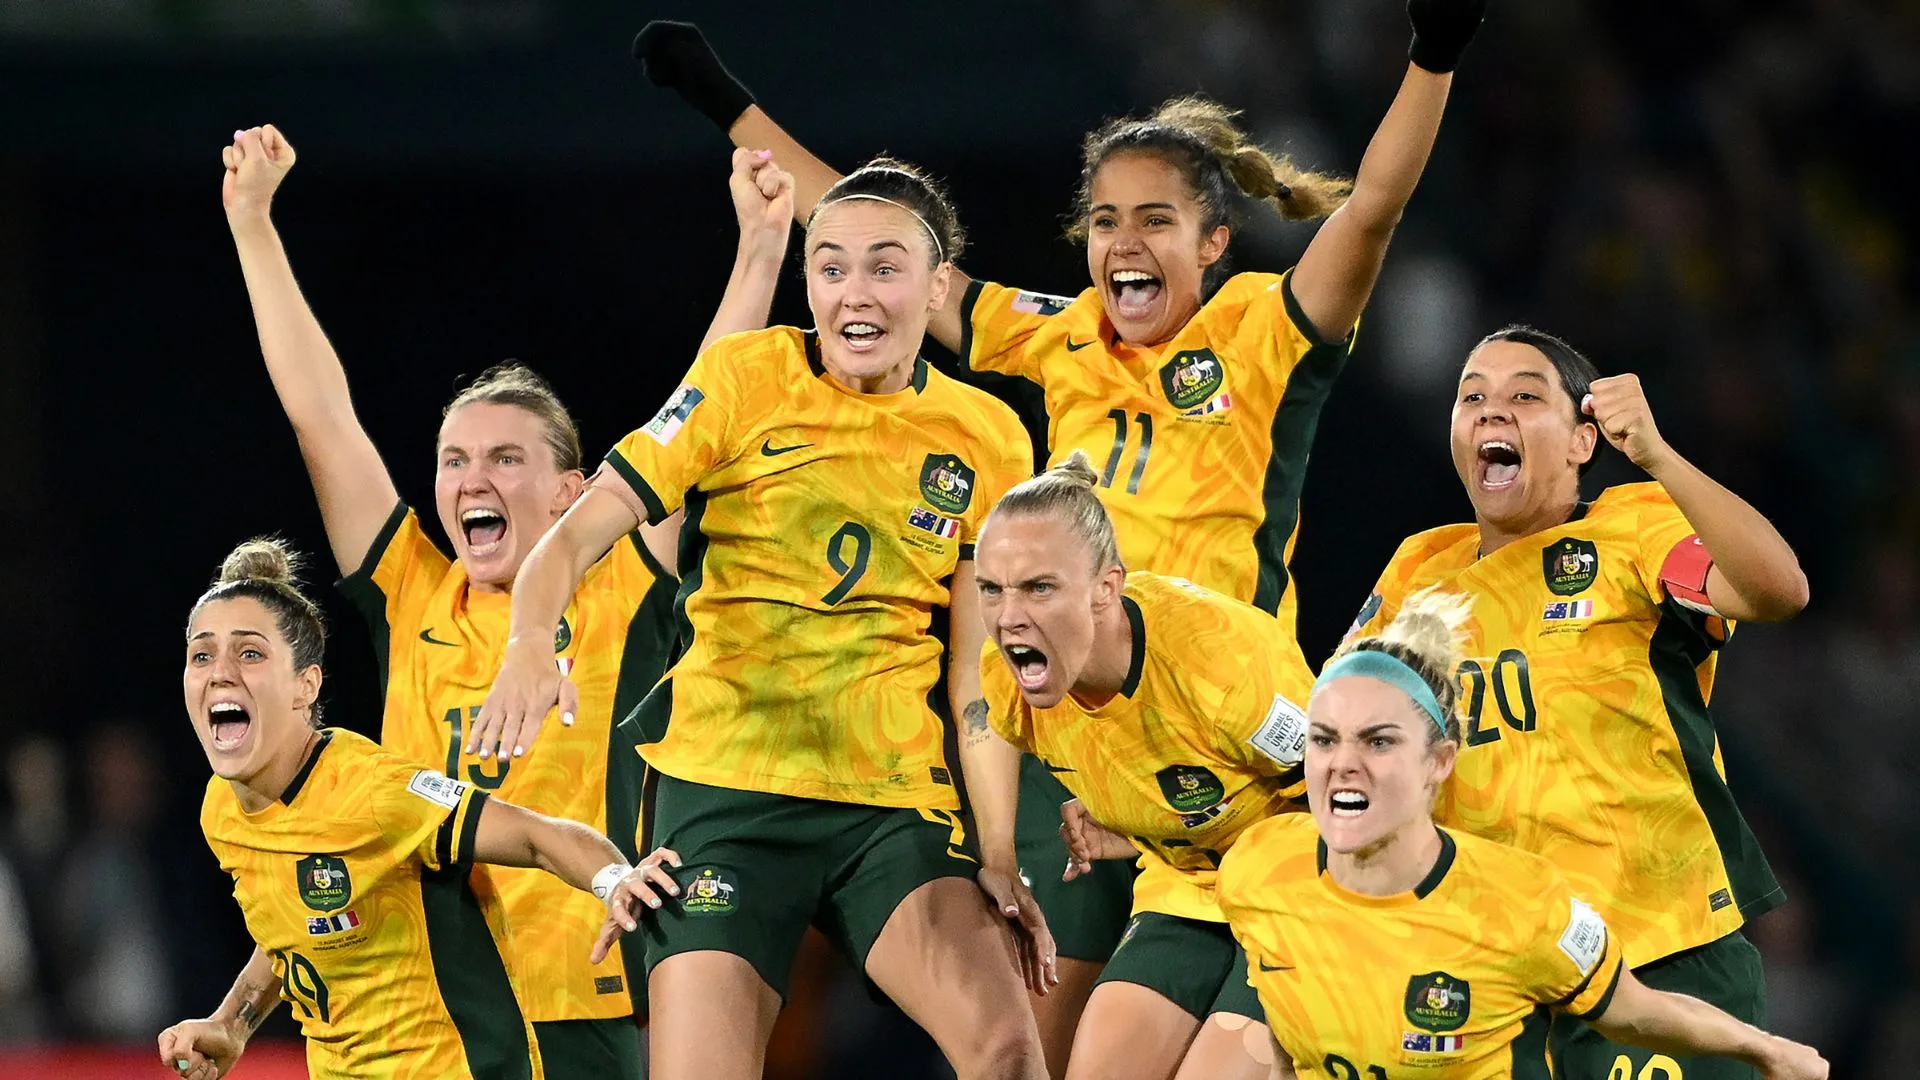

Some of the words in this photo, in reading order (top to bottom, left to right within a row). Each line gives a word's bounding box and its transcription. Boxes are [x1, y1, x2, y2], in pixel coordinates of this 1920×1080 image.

[1177, 376, 1215, 399] AUSTRALIA
[1100, 408, 1153, 495] 11
[926, 484, 961, 504] AUSTRALIA
[820, 520, 871, 606] 9
[1554, 572, 1590, 583] AUSTRALIA
[1456, 648, 1536, 747] 20
[1271, 715, 1294, 747] UNITES
[1175, 785, 1215, 800] AUSTRALIA
[308, 887, 343, 897] AUSTRALIA
[686, 896, 729, 907] AUSTRALIA
[1414, 1006, 1458, 1018] AUSTRALIA
